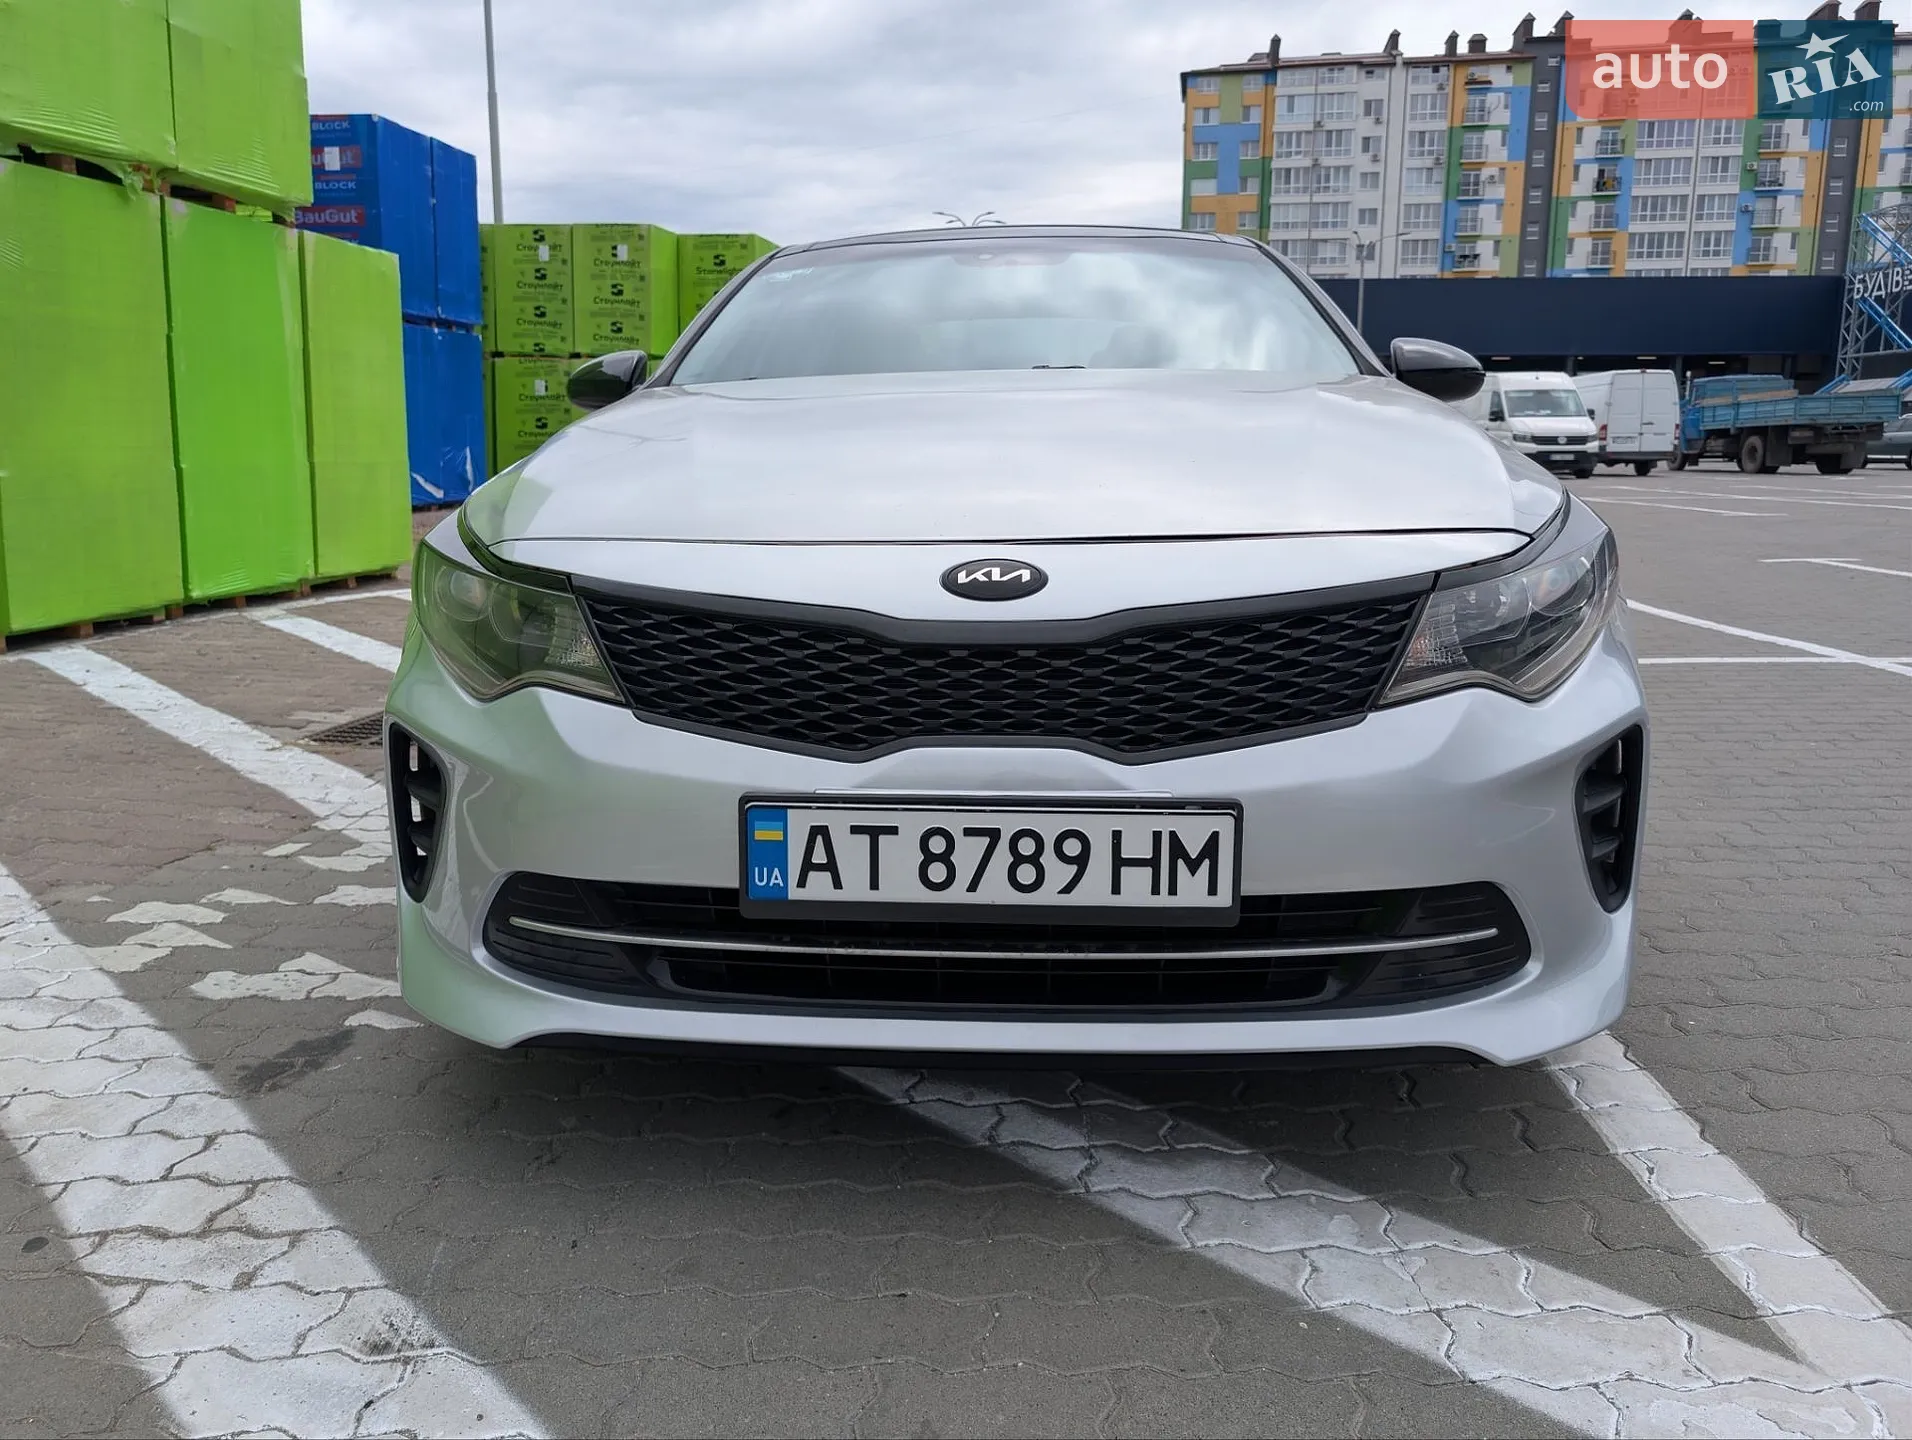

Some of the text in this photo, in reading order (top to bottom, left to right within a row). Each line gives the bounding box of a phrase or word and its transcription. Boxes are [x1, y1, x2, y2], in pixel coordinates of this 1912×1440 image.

[312, 121, 351, 131] BLOCK
[315, 181, 357, 190] BLOCK
[294, 208, 359, 224] BauGut
[957, 567, 1031, 584] KIA
[918, 826, 1092, 895] 8789
[754, 866, 785, 887] UA
